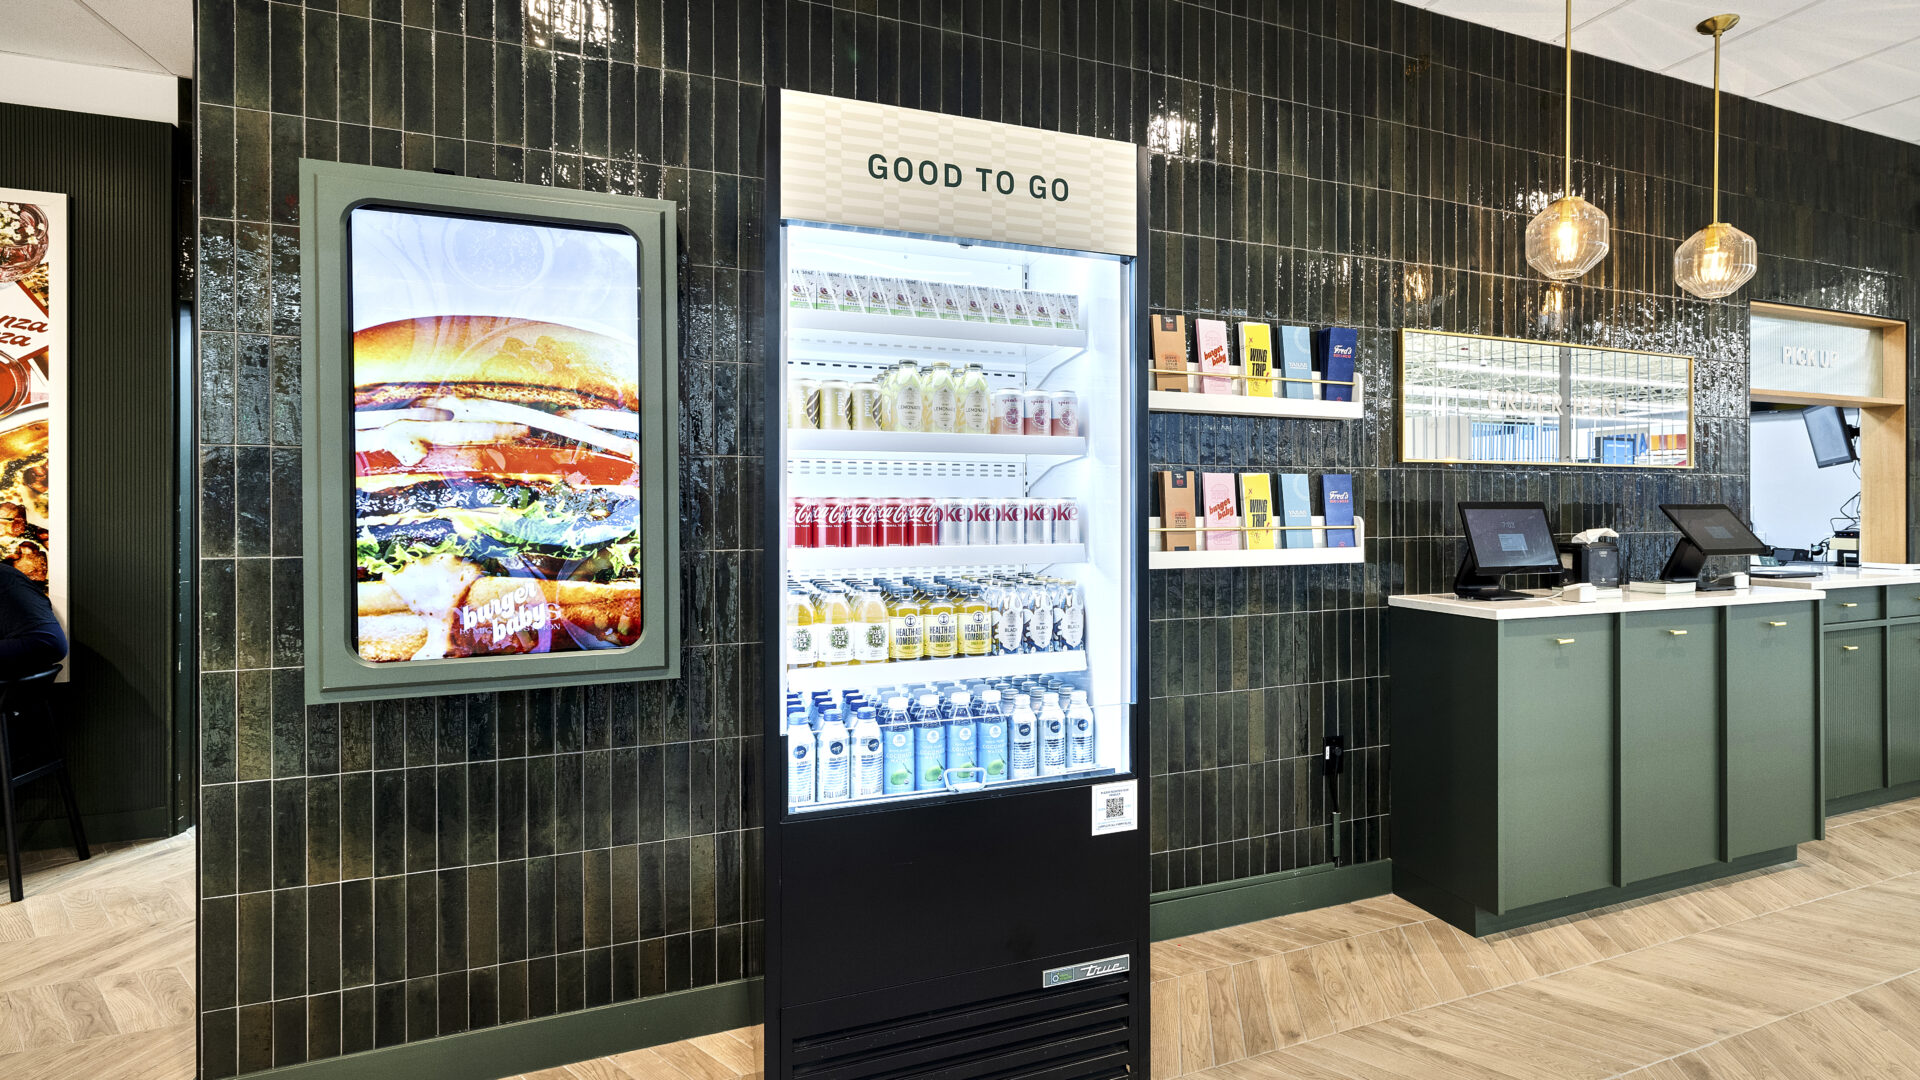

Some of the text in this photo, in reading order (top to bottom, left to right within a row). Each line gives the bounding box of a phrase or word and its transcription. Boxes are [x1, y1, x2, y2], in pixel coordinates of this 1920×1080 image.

[868, 153, 1069, 202] GOOD TO GO
[1204, 345, 1224, 360] burger
[1250, 348, 1268, 362] WING
[1333, 345, 1352, 354] Fred's
[1781, 345, 1839, 369] PICK UP
[1211, 354, 1227, 367] baby
[1252, 362, 1267, 377] TRIP
[1487, 389, 1625, 418] ORDER HERE
[1329, 490, 1349, 500] Fred's
[1208, 497, 1231, 515] burger
[1217, 506, 1234, 520] baby
[1250, 499, 1268, 513] WING
[1252, 514, 1267, 527] TRIP
[463, 582, 537, 632] burger
[492, 602, 546, 644] baby
